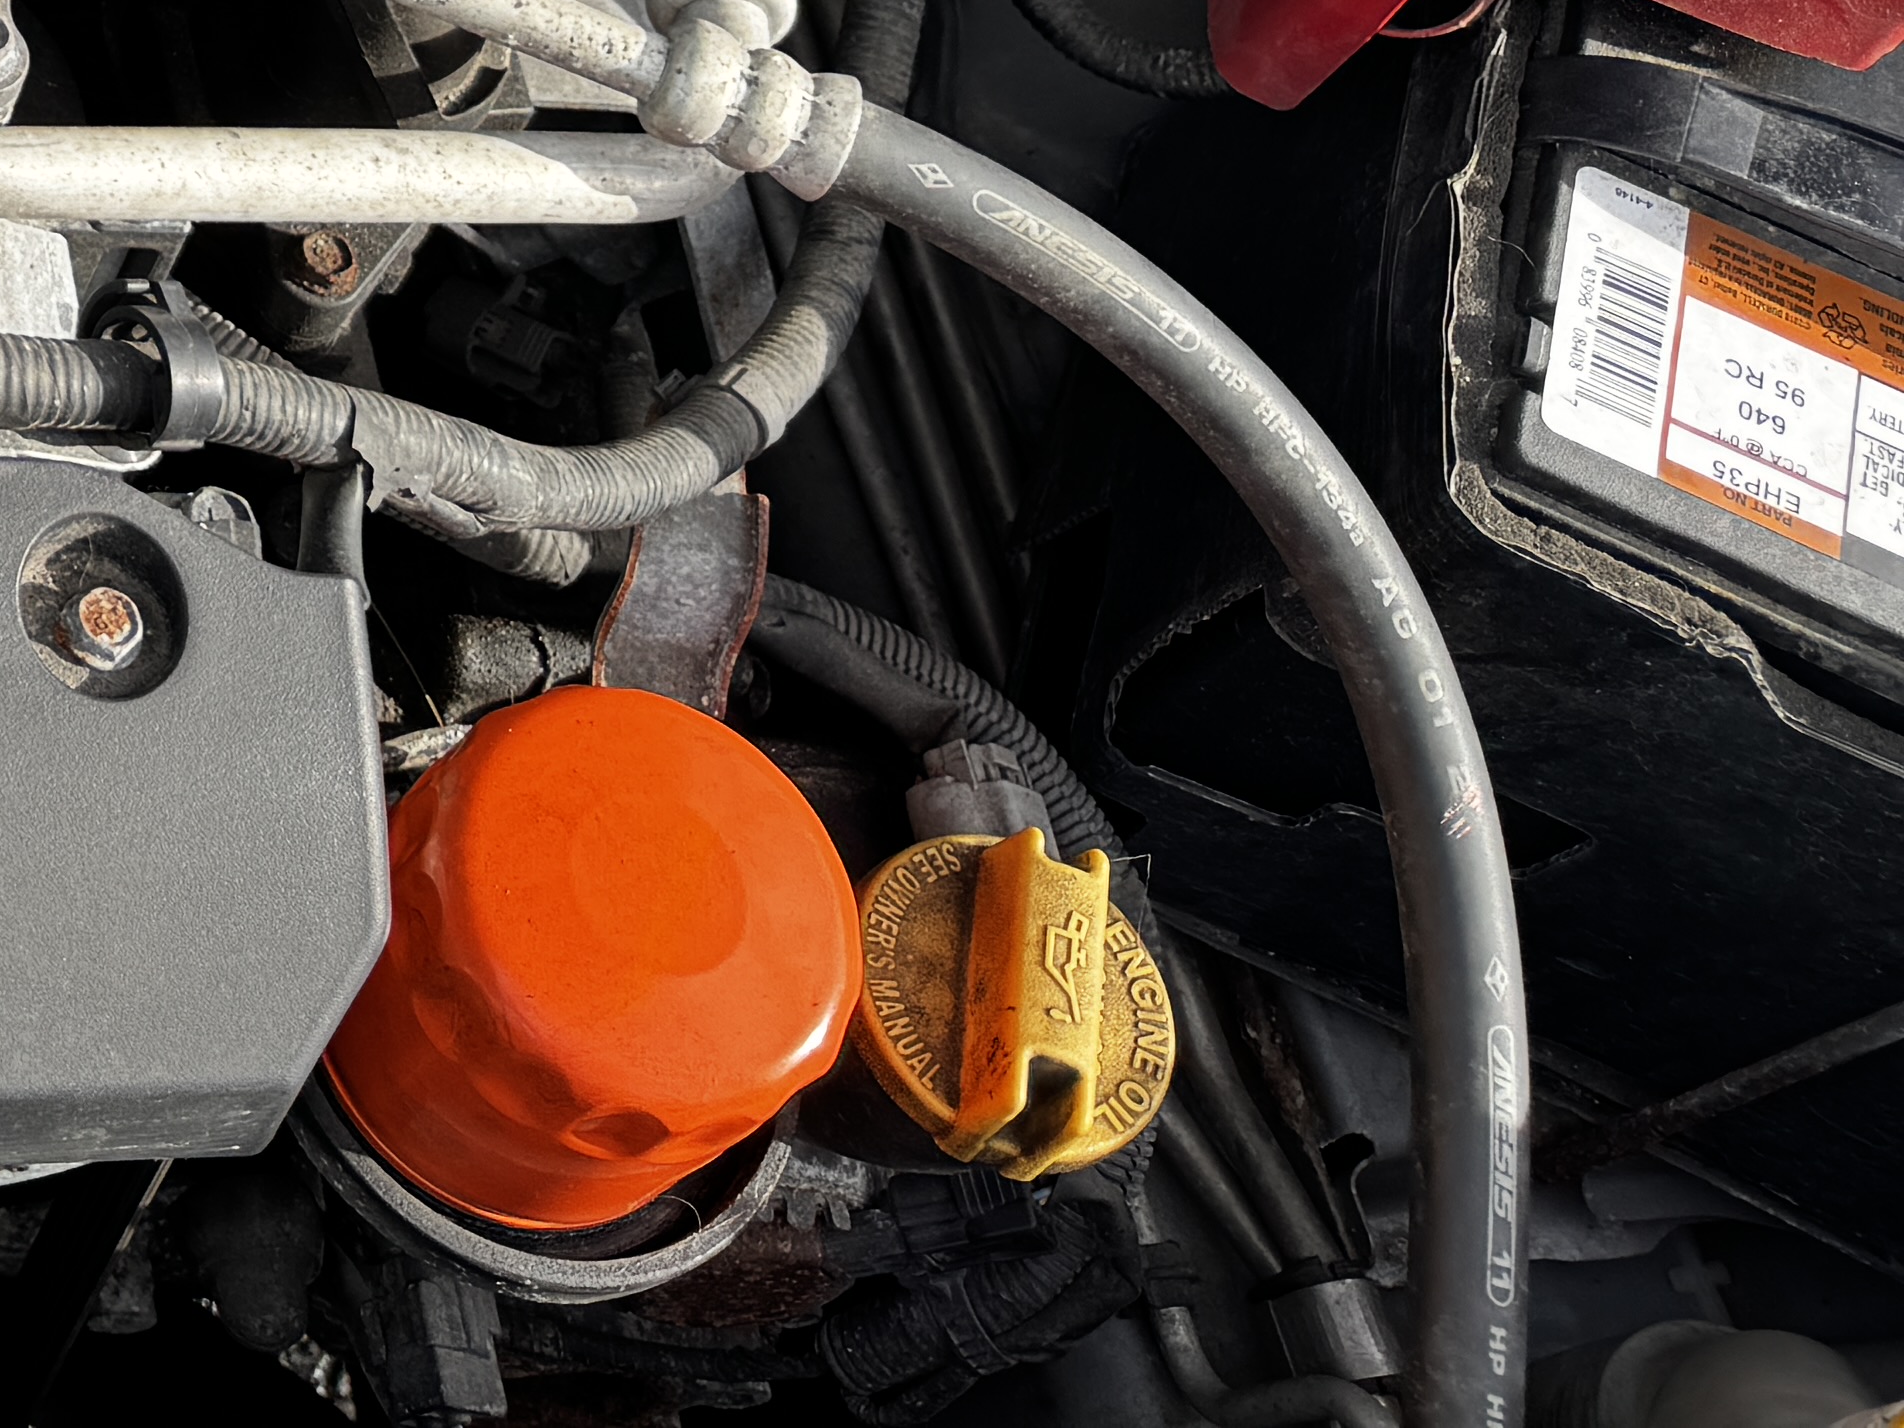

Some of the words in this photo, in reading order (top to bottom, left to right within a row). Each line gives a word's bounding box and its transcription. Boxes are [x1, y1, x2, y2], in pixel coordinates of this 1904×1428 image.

[1724, 359, 1764, 389] RC
[1775, 380, 1805, 407] 95
[1739, 400, 1786, 435] 640
[1770, 450, 1808, 478] CCA
[1712, 460, 1801, 514] EHP35
[1721, 484, 1748, 507] NO.
[1752, 497, 1793, 527] PART
[913, 842, 962, 884] SEE
[865, 866, 918, 971] OWNER'S
[1104, 920, 1172, 1080] ENGINE
[867, 978, 944, 1089] MANUAL
[1093, 1079, 1152, 1133] OIL
